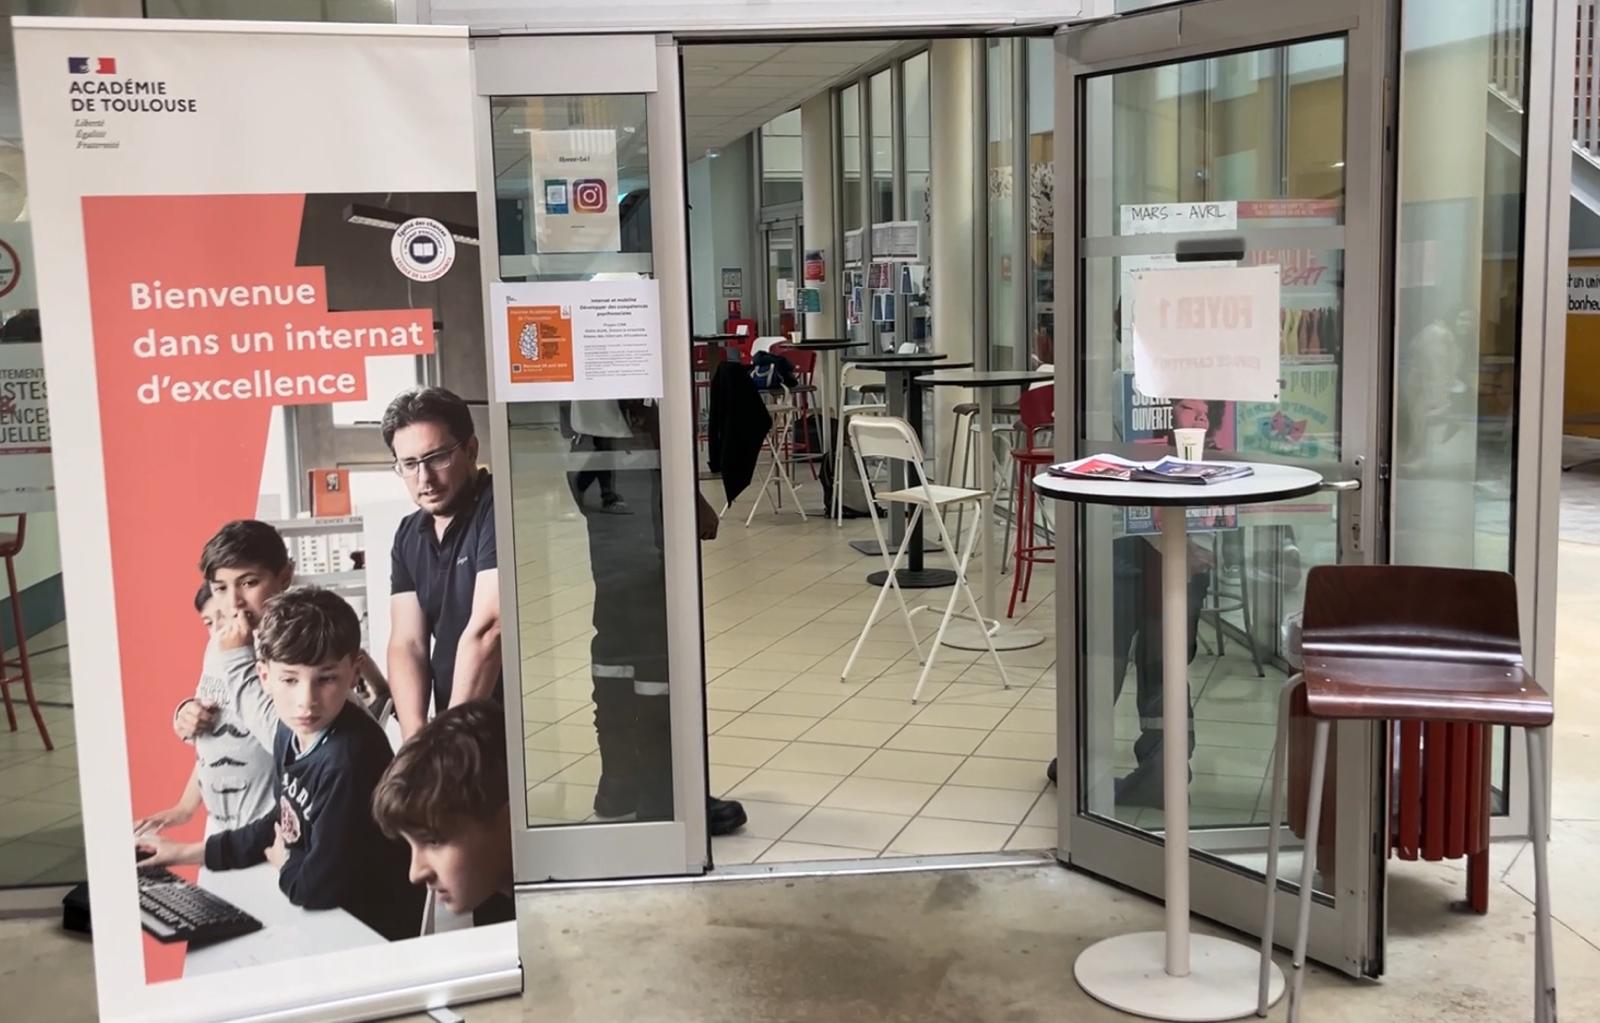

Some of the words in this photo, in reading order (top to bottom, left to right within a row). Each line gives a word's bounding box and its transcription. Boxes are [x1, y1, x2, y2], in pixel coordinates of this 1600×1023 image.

[69, 79, 167, 95] ACADÉMIE
[72, 98, 96, 112] DE
[102, 98, 198, 112] TOULOUSE
[1131, 206, 1169, 221] MARS
[130, 280, 316, 311] Bienvenue
[133, 329, 220, 358] dans
[231, 331, 274, 354] un
[285, 322, 424, 351] internat
[137, 369, 356, 404] d'excellence
[1132, 406, 1174, 431] OUVERTE
